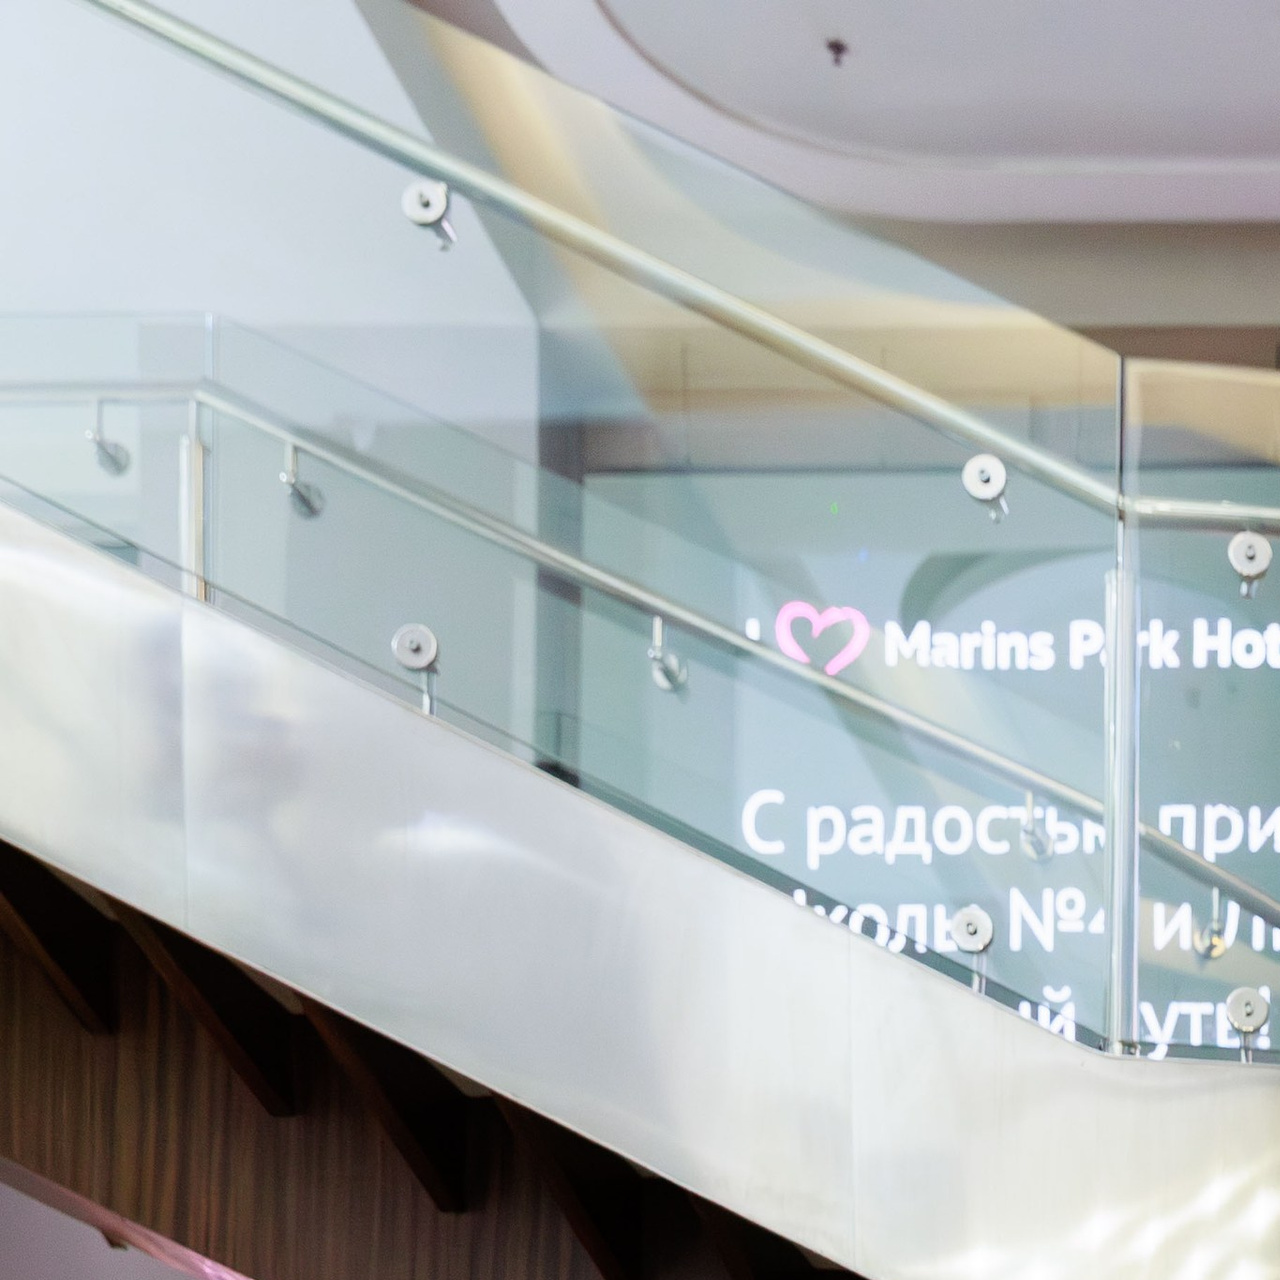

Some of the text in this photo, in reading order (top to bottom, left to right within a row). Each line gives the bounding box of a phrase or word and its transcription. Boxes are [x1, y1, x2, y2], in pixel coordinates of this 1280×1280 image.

[884, 620, 1056, 671] Marins
[1069, 618, 1181, 670] Pk
[741, 789, 786, 856] С
[1153, 902, 1192, 951] и
